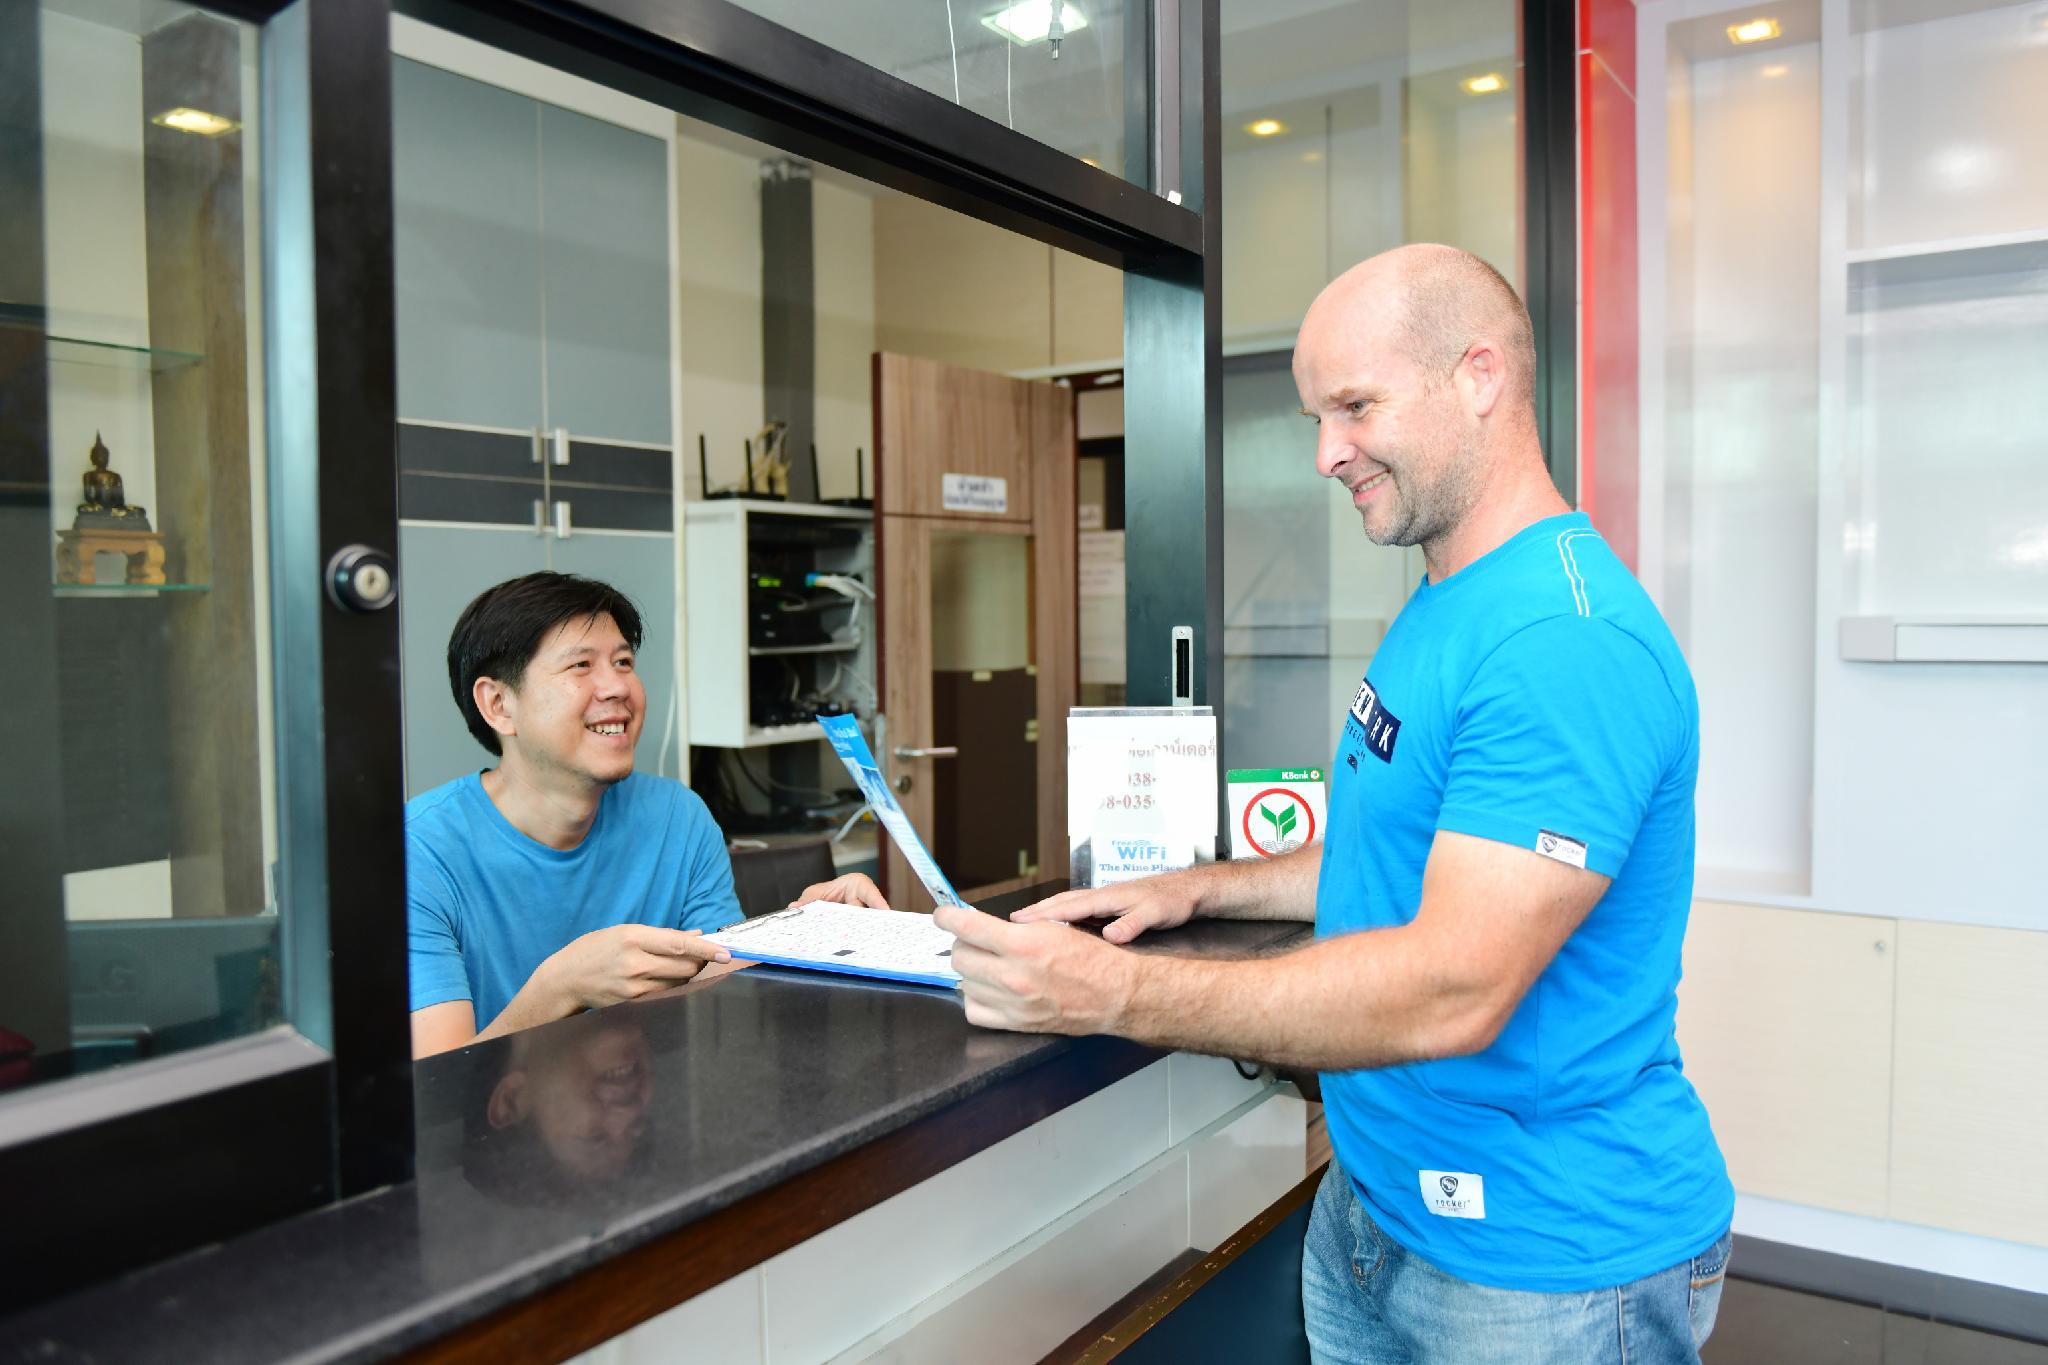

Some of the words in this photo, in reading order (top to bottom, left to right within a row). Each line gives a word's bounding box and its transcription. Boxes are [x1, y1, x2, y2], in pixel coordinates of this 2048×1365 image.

[1281, 770, 1309, 780] KBank
[1099, 795, 1156, 810] 8-035
[1117, 846, 1166, 860] WiFi
[1098, 863, 1120, 872] The
[1122, 863, 1149, 872] Nine
[1435, 1199, 1467, 1209] rocker
